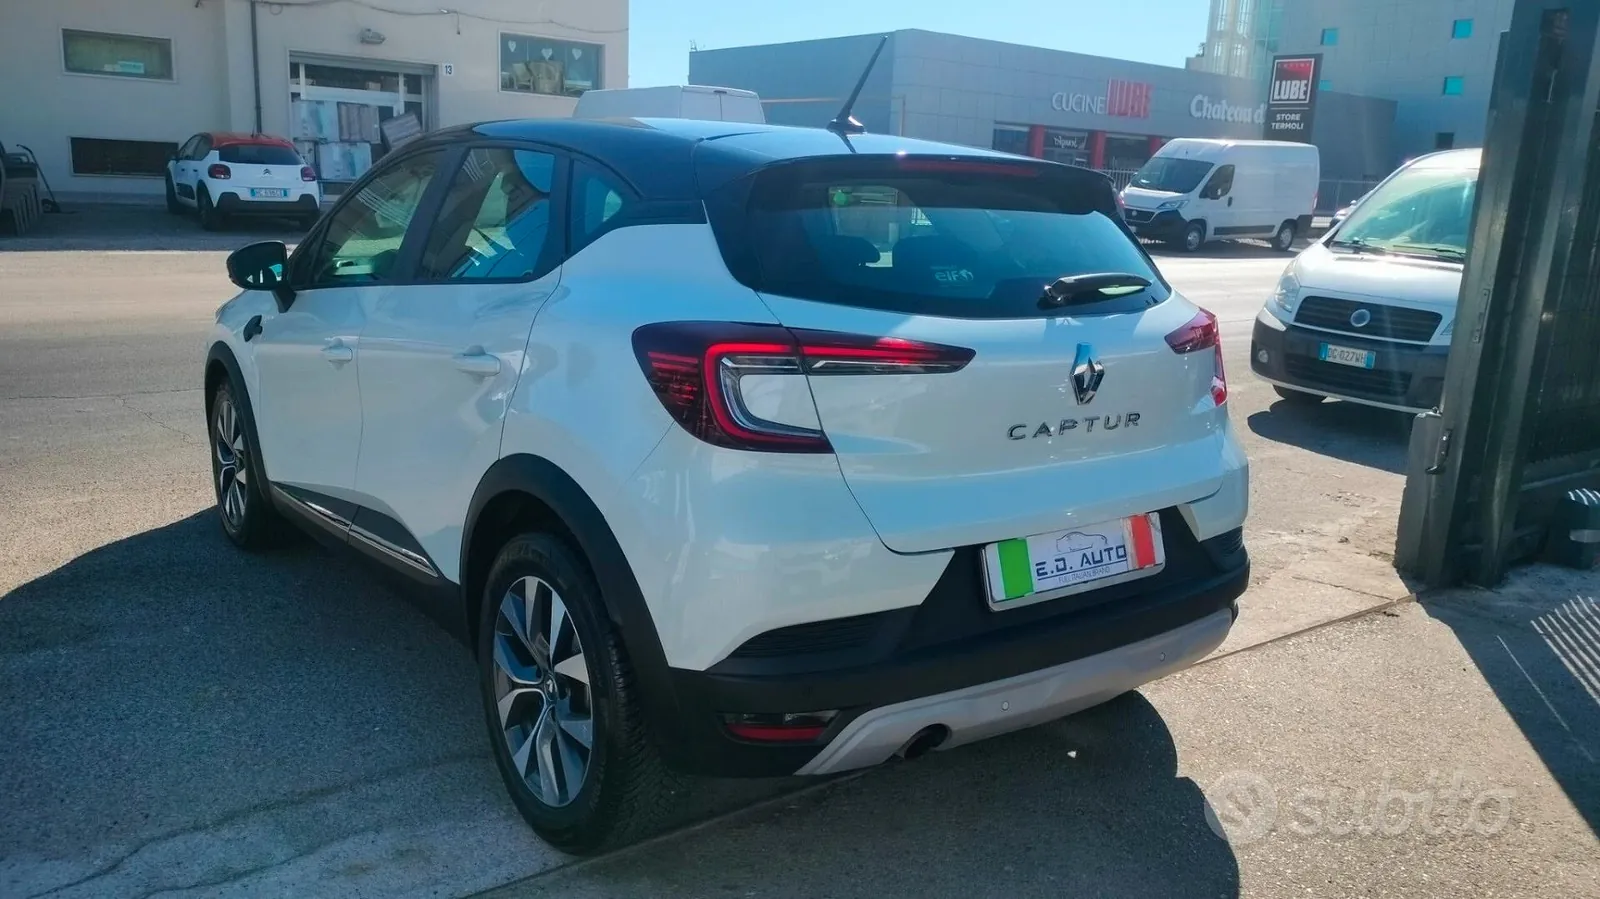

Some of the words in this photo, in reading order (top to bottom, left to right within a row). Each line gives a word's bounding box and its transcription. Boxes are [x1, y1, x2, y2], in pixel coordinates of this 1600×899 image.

[445, 65, 453, 75] 13
[1273, 80, 1308, 100] LUBE
[1052, 92, 1106, 115] CUCINE
[1190, 94, 1252, 123] Chateau
[1271, 122, 1304, 130] TERMOLI
[1276, 113, 1301, 121] STORE
[1007, 412, 1141, 441] CAPTUR
[1080, 544, 1127, 567] AUTO
